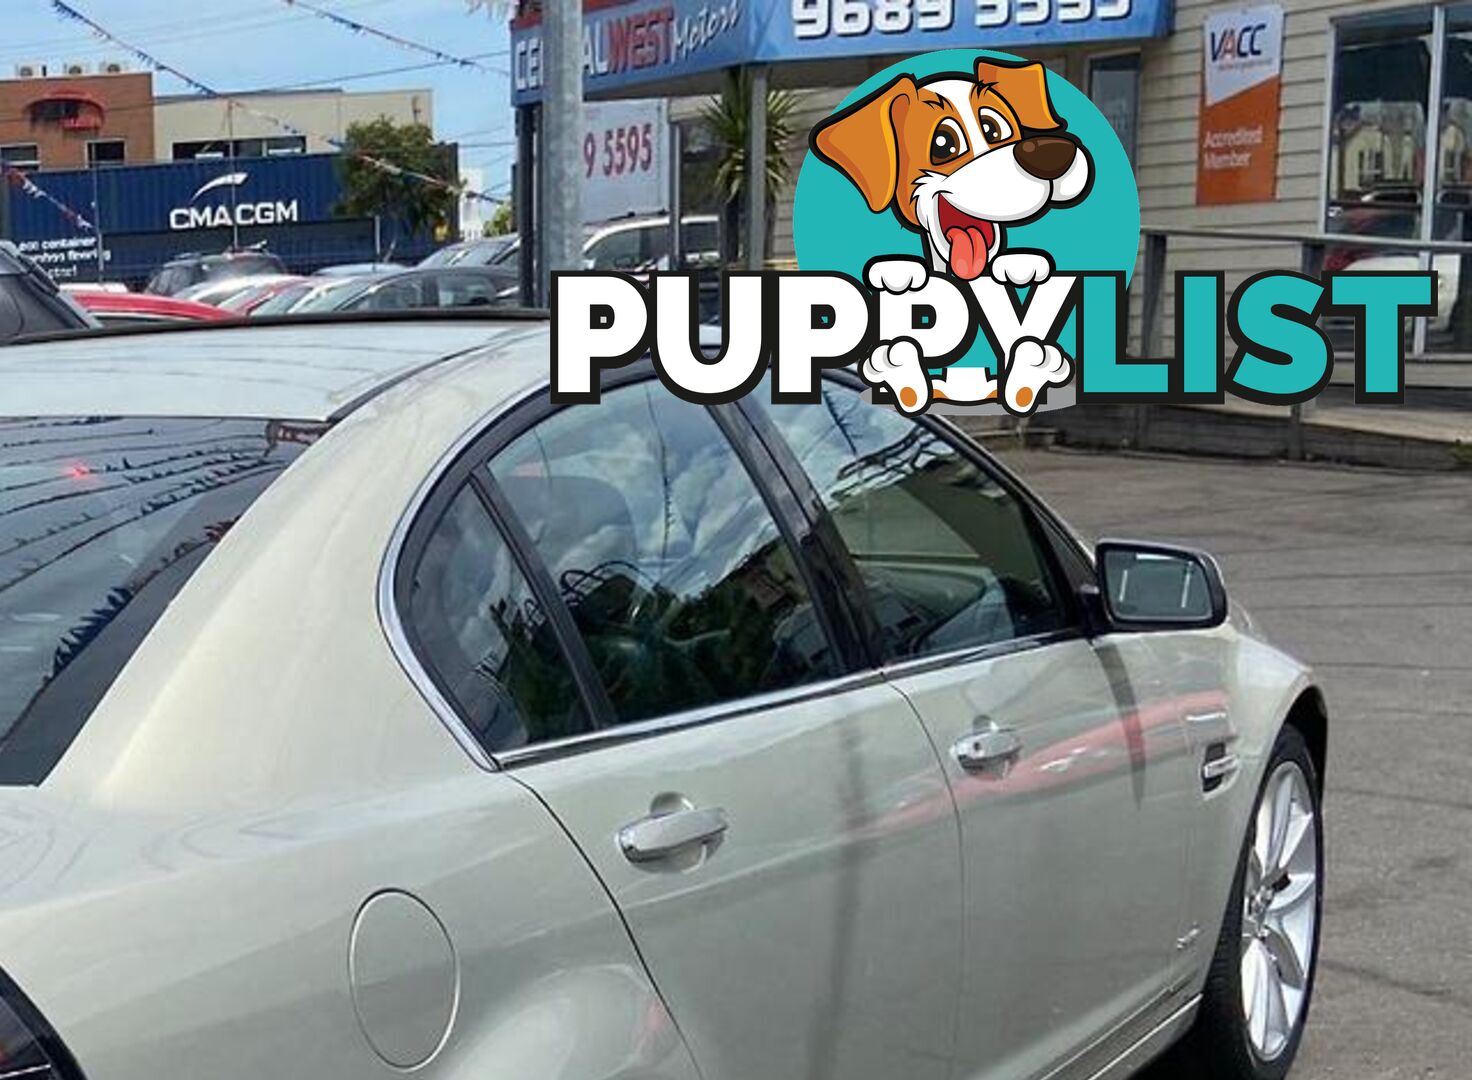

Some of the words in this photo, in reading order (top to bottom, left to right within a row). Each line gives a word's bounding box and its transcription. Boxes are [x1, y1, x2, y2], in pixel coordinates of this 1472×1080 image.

[1210, 23, 1267, 61] VACC
[602, 123, 653, 177] 5595
[1203, 149, 1252, 170] Member
[169, 204, 233, 229] CMA
[234, 200, 298, 225] CGM
